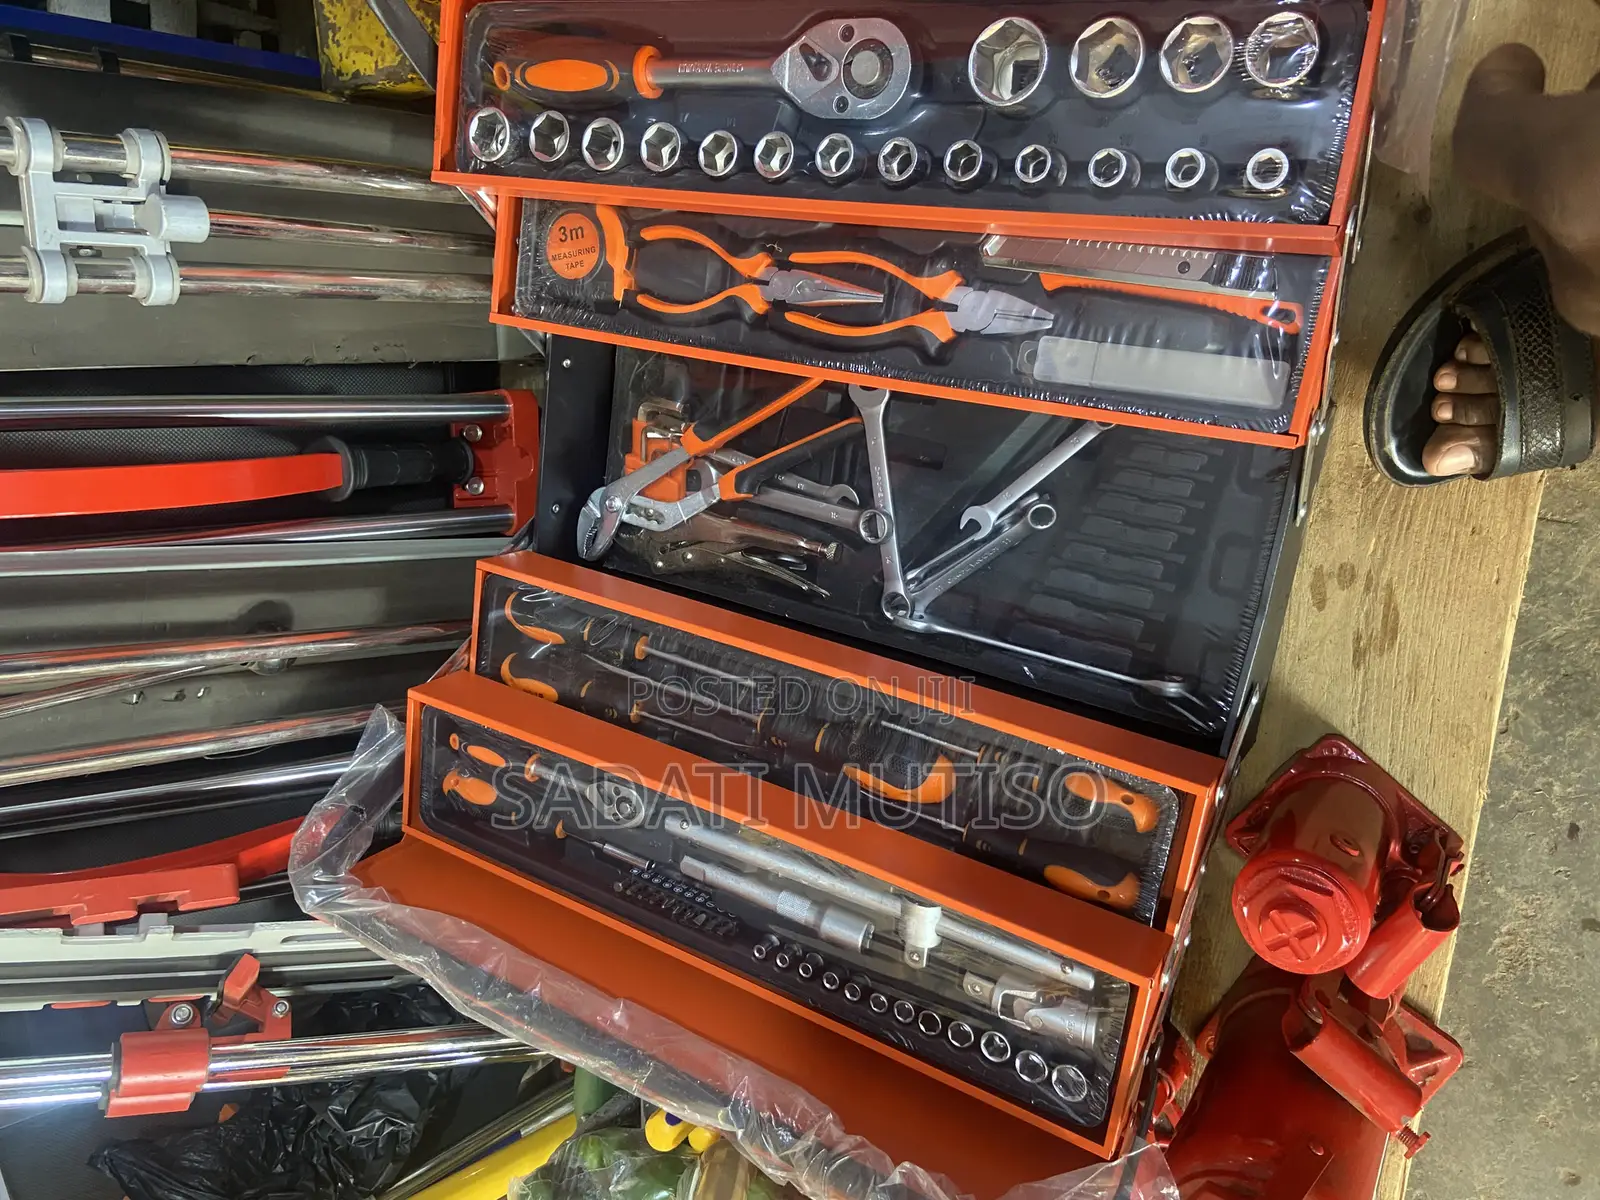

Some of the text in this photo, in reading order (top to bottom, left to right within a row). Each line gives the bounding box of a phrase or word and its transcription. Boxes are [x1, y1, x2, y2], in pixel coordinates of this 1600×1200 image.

[558, 225, 584, 243] 3m
[551, 246, 596, 261] MEASURING
[566, 260, 585, 270] TAPE
